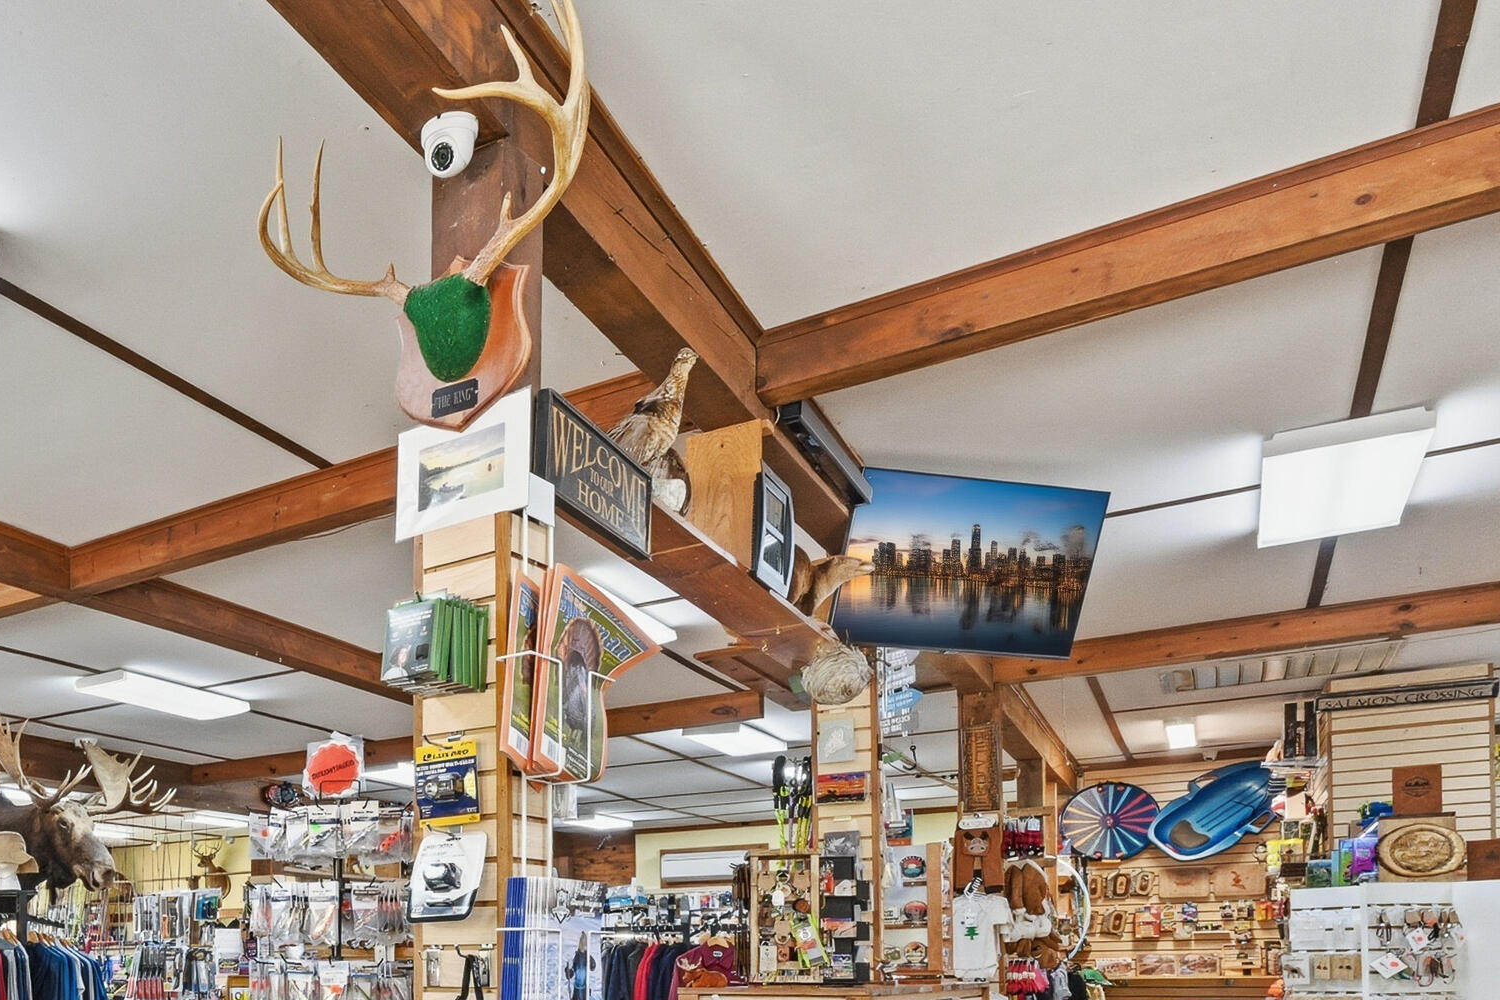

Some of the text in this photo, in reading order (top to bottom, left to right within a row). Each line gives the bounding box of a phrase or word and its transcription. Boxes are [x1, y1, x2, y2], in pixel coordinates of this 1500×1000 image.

[552, 405, 648, 537] WELCOME
[590, 467, 600, 487] TO
[577, 478, 625, 529] HOME
[1325, 687, 1484, 710] SALMON CROSSING
